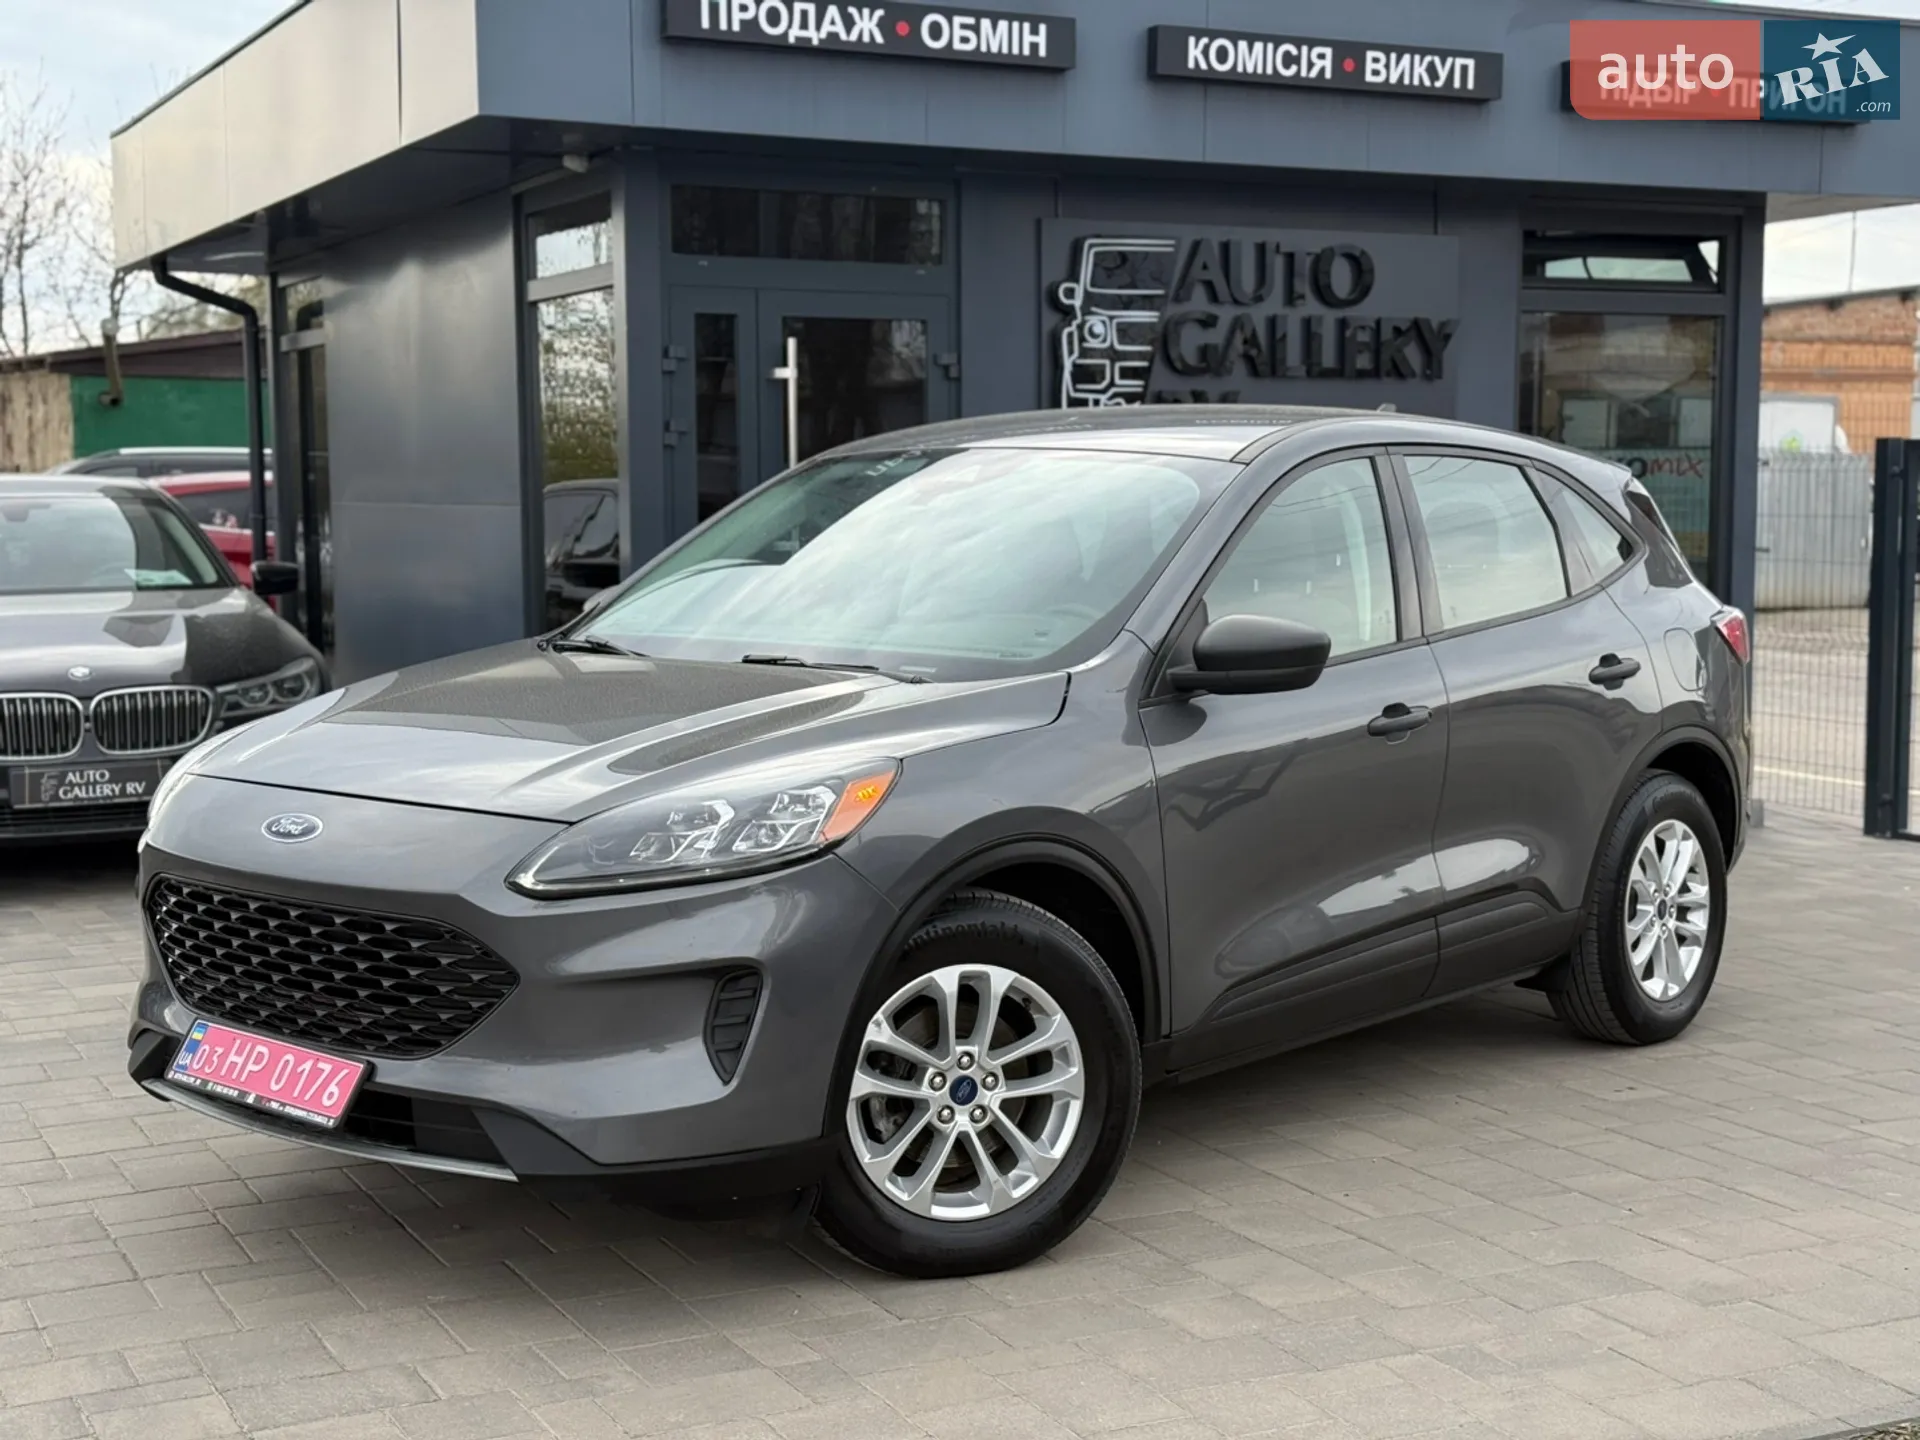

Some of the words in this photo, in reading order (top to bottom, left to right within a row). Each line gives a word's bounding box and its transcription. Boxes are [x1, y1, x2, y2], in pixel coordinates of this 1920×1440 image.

[701, 0, 885, 46] ПРОДАЖ
[920, 13, 1048, 57] ОБМІН
[1186, 35, 1334, 80] КОМІСІЯ
[1364, 50, 1476, 90] ВИКУП
[1169, 238, 1375, 310] AUTO
[1160, 309, 1461, 381] GALLERY
[58, 782, 122, 800] GALLERY
[126, 781, 146, 796] RV
[65, 769, 110, 785] AUTO
[270, 817, 309, 835] Ford
[178, 1049, 192, 1066] UA
[269, 1053, 350, 1107] 0176
